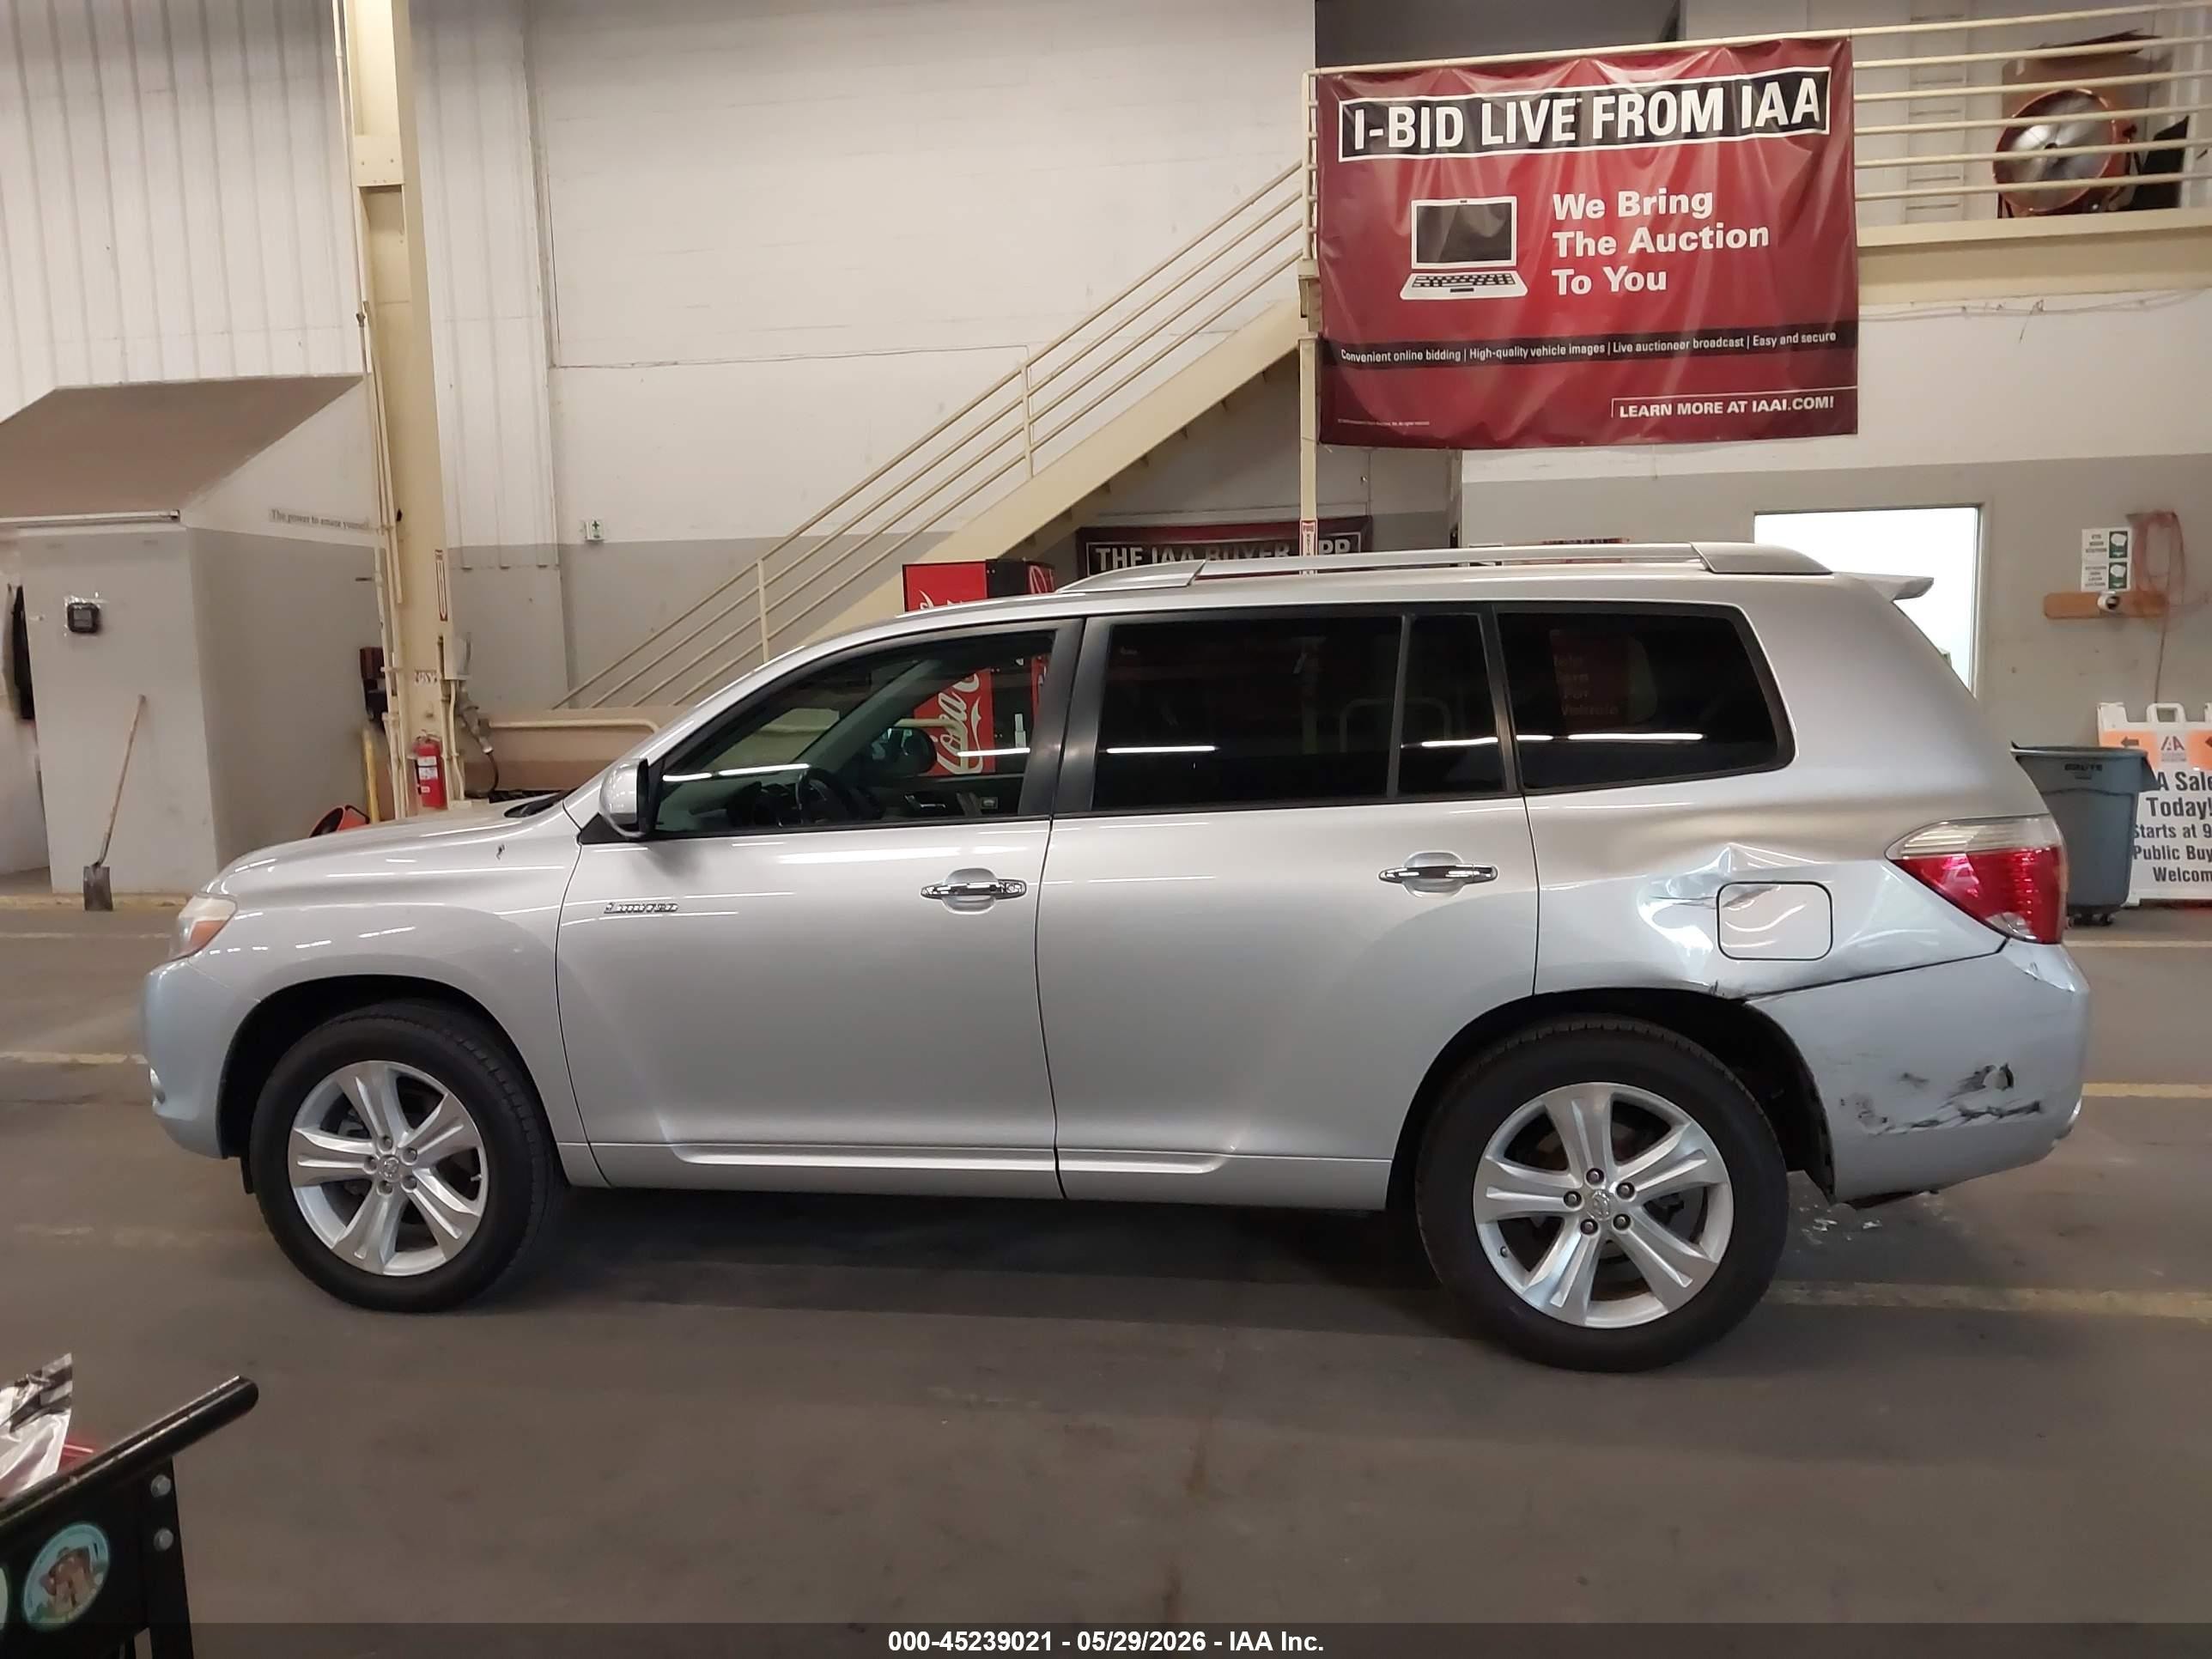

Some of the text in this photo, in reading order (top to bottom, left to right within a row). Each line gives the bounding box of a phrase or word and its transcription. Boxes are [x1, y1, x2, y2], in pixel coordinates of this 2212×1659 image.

[1354, 77, 1820, 150] I-BID LIVE FROM IAA
[1553, 187, 1713, 221] We Bring
[1552, 222, 1770, 258] The Auction
[1551, 264, 1667, 295] To You
[1340, 348, 1391, 363] Convenient
[1394, 348, 1424, 362] online
[1425, 347, 1462, 362] bidding
[1469, 344, 1528, 361] High-quality
[1530, 343, 1566, 357] vehicle
[1569, 342, 1605, 356] images
[1613, 341, 1633, 354] Live
[1635, 339, 1690, 353] auctioneer
[1692, 336, 1744, 349] broadcast
[1753, 334, 1778, 349] Easy
[1779, 332, 1799, 345] and
[1801, 331, 1837, 344] secure
[1620, 395, 1834, 418] LEARN MORE AT IAAI.COM!
[1096, 546, 1143, 571] THE
[2135, 823, 2177, 839] Starts
[2182, 823, 2197, 839] at
[2134, 844, 2180, 860] Public
